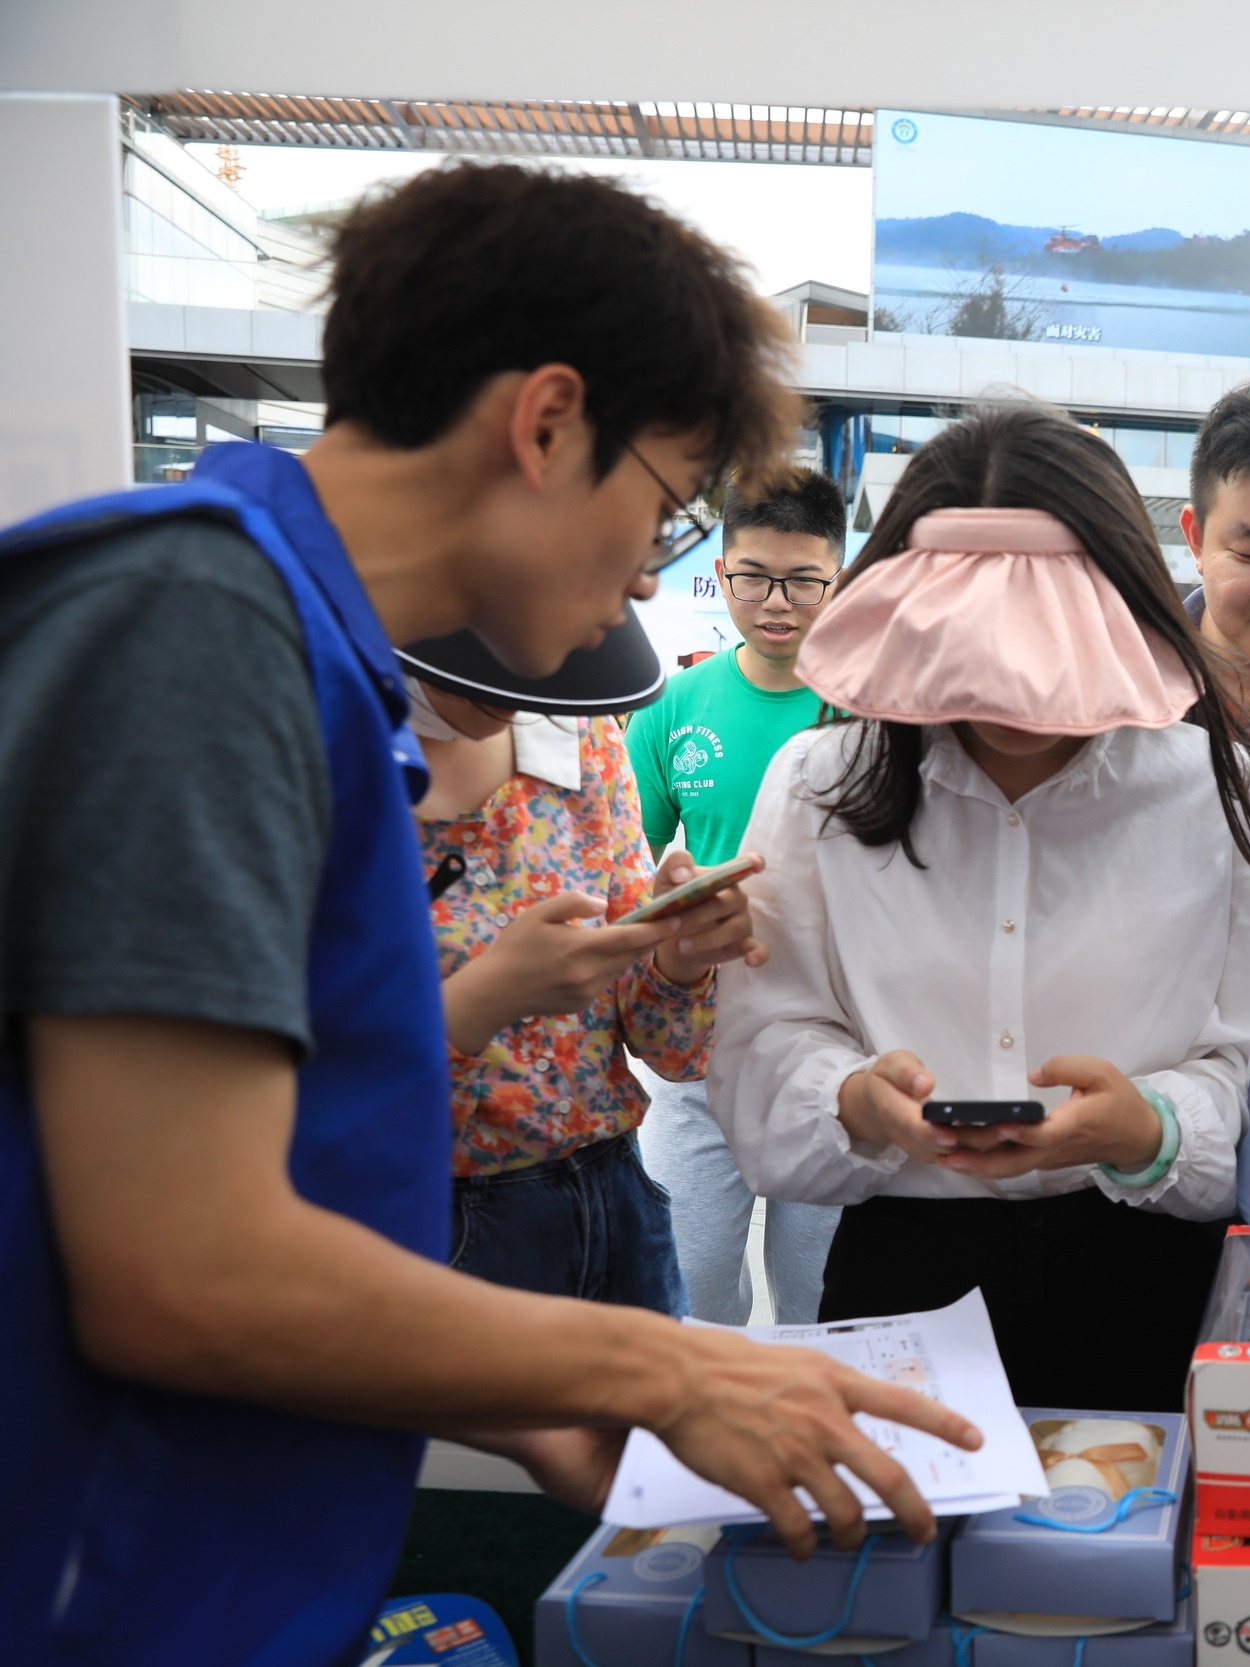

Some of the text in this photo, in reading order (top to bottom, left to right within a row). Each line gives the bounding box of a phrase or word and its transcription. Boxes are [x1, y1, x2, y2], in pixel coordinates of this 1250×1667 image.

[1046, 324, 1102, 342] 面对灾害
[693, 576, 718, 598] 防
[695, 725, 724, 758] FITNESS
[693, 779, 714, 789] CLUB
